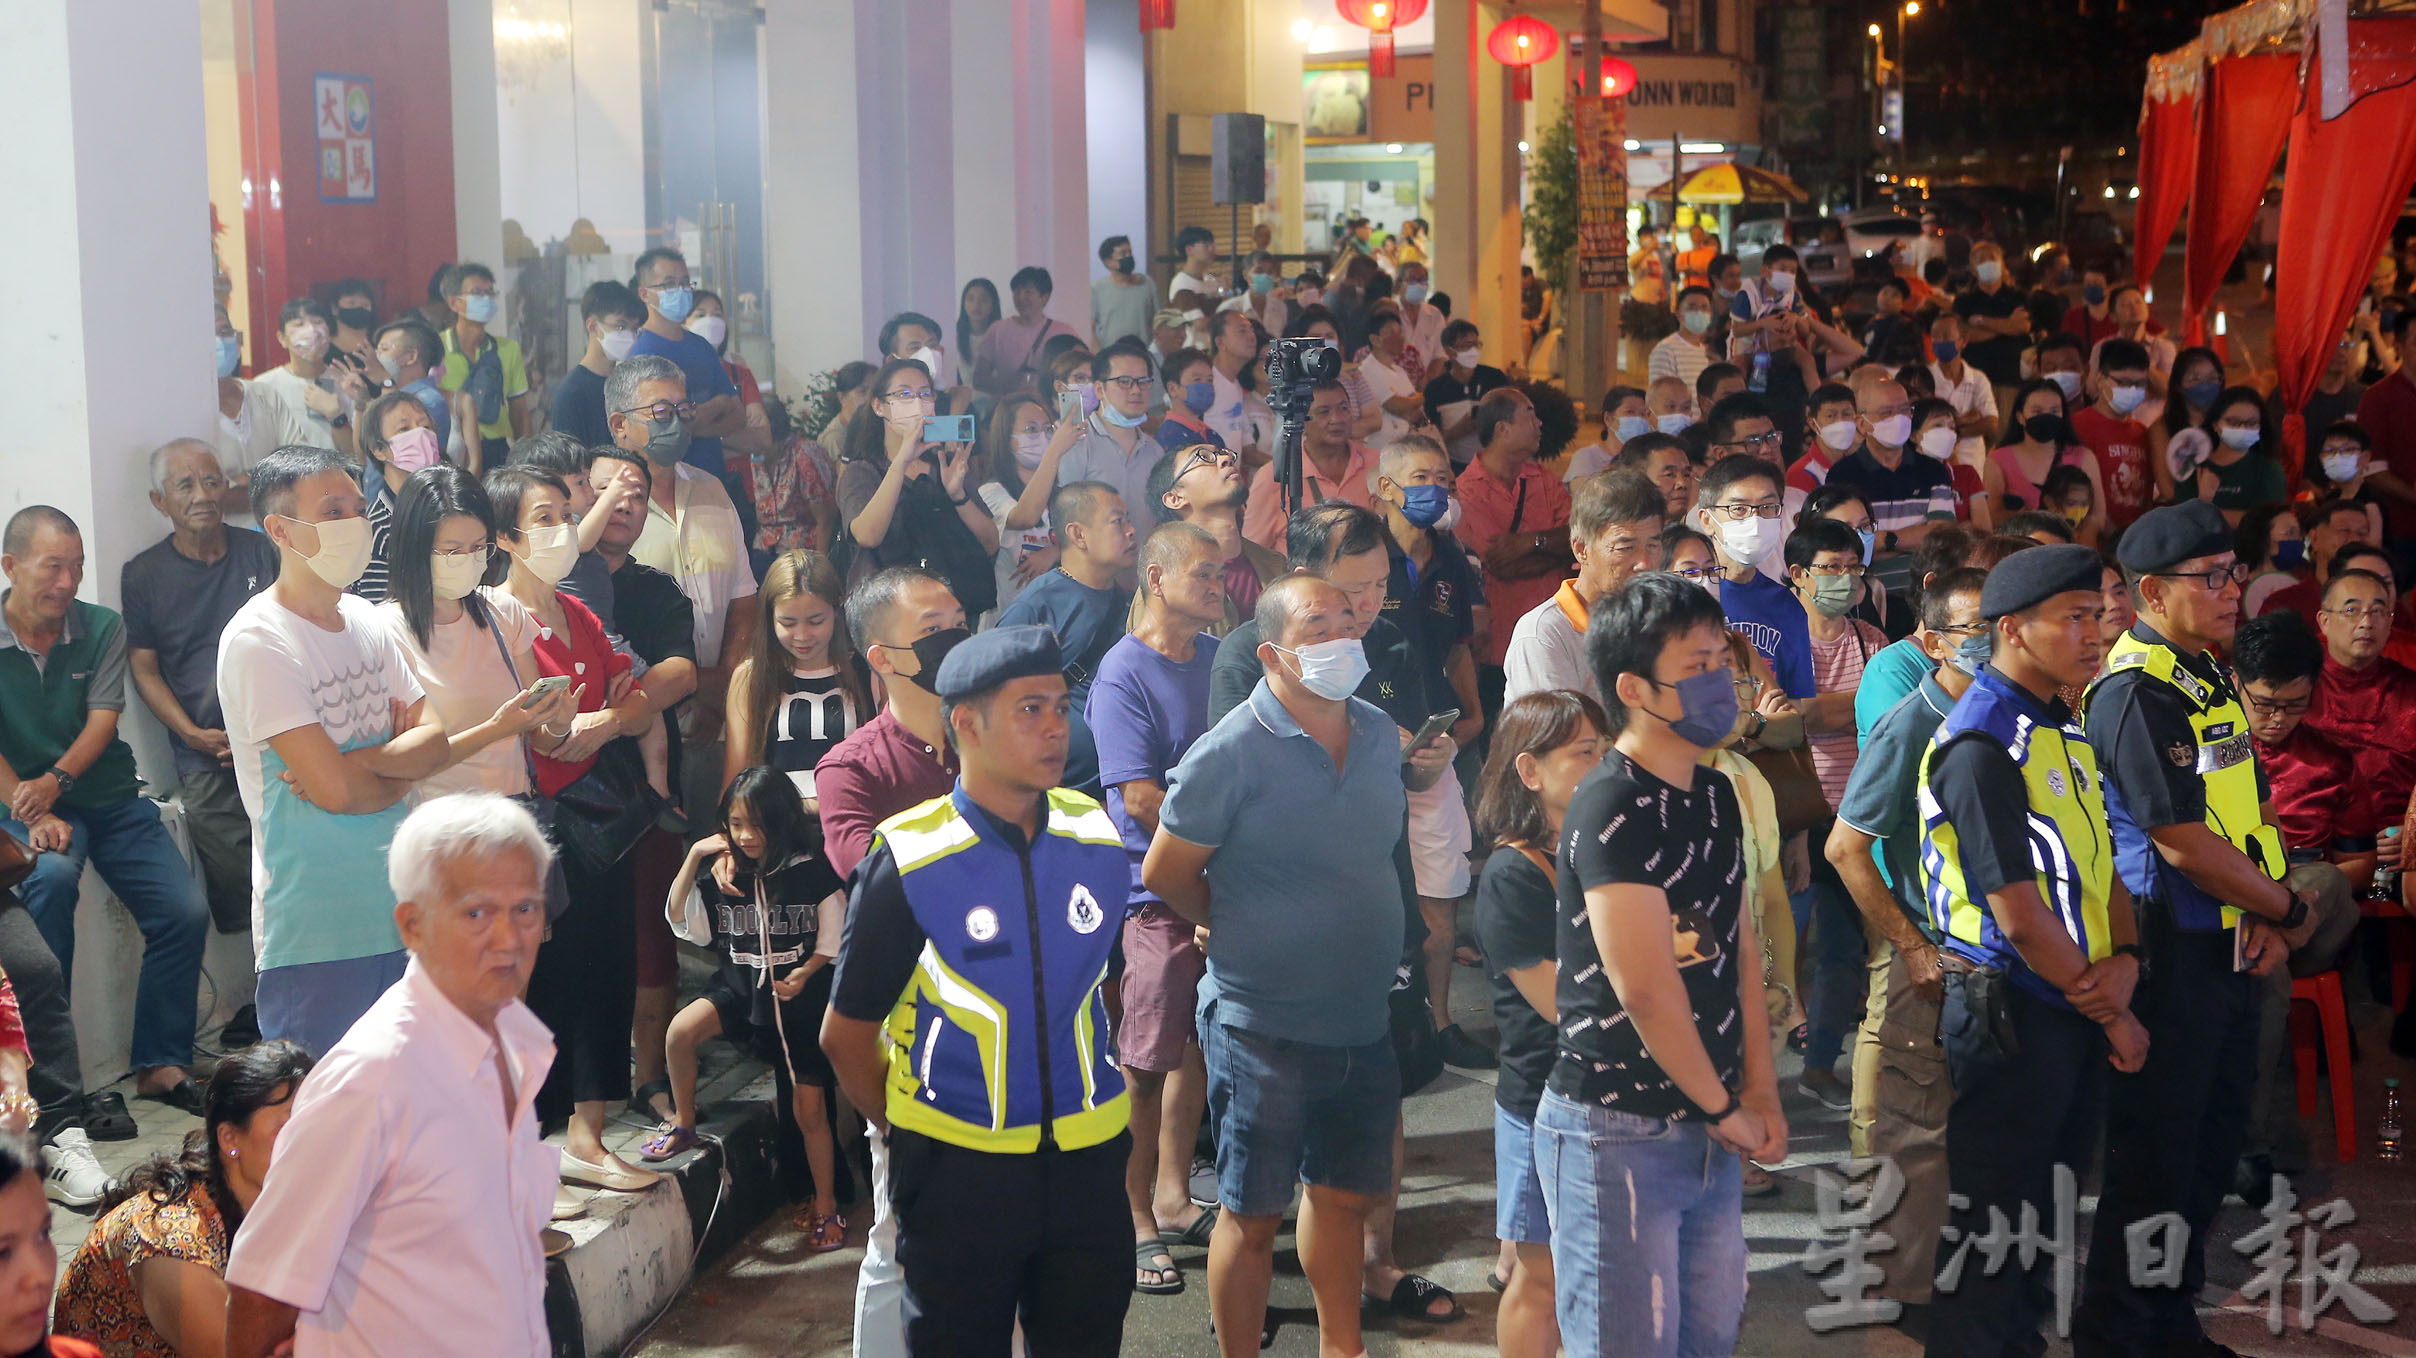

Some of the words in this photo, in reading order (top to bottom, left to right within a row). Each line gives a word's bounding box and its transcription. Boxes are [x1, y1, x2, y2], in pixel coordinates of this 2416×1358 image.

[321, 87, 344, 132] 大
[1406, 83, 1434, 112] PI
[715, 903, 818, 936] BOOLYN
